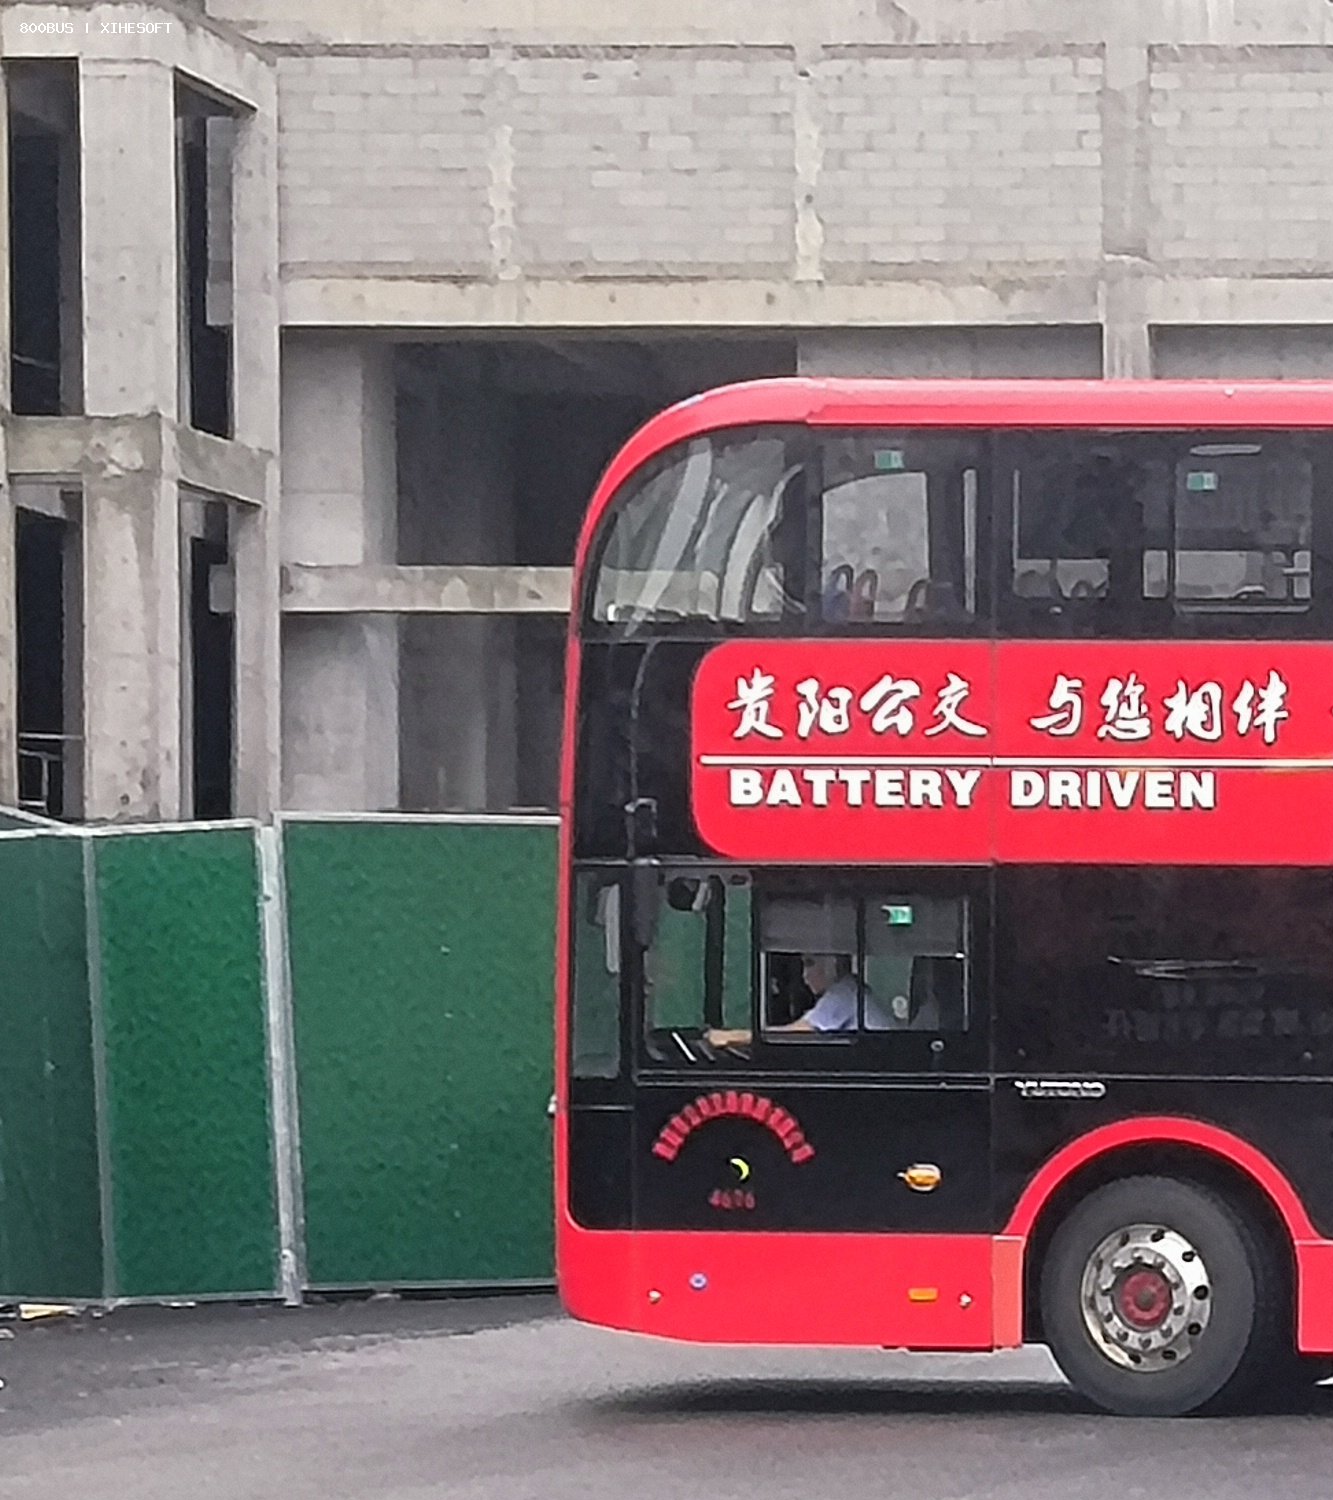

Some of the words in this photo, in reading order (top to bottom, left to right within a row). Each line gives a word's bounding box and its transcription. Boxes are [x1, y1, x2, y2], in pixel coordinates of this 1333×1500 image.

[727, 667, 989, 740] 贵阳公交
[1030, 669, 1290, 745] 与您相伴
[729, 768, 983, 808] BATTERY
[1010, 770, 1217, 810] DRIVEN
